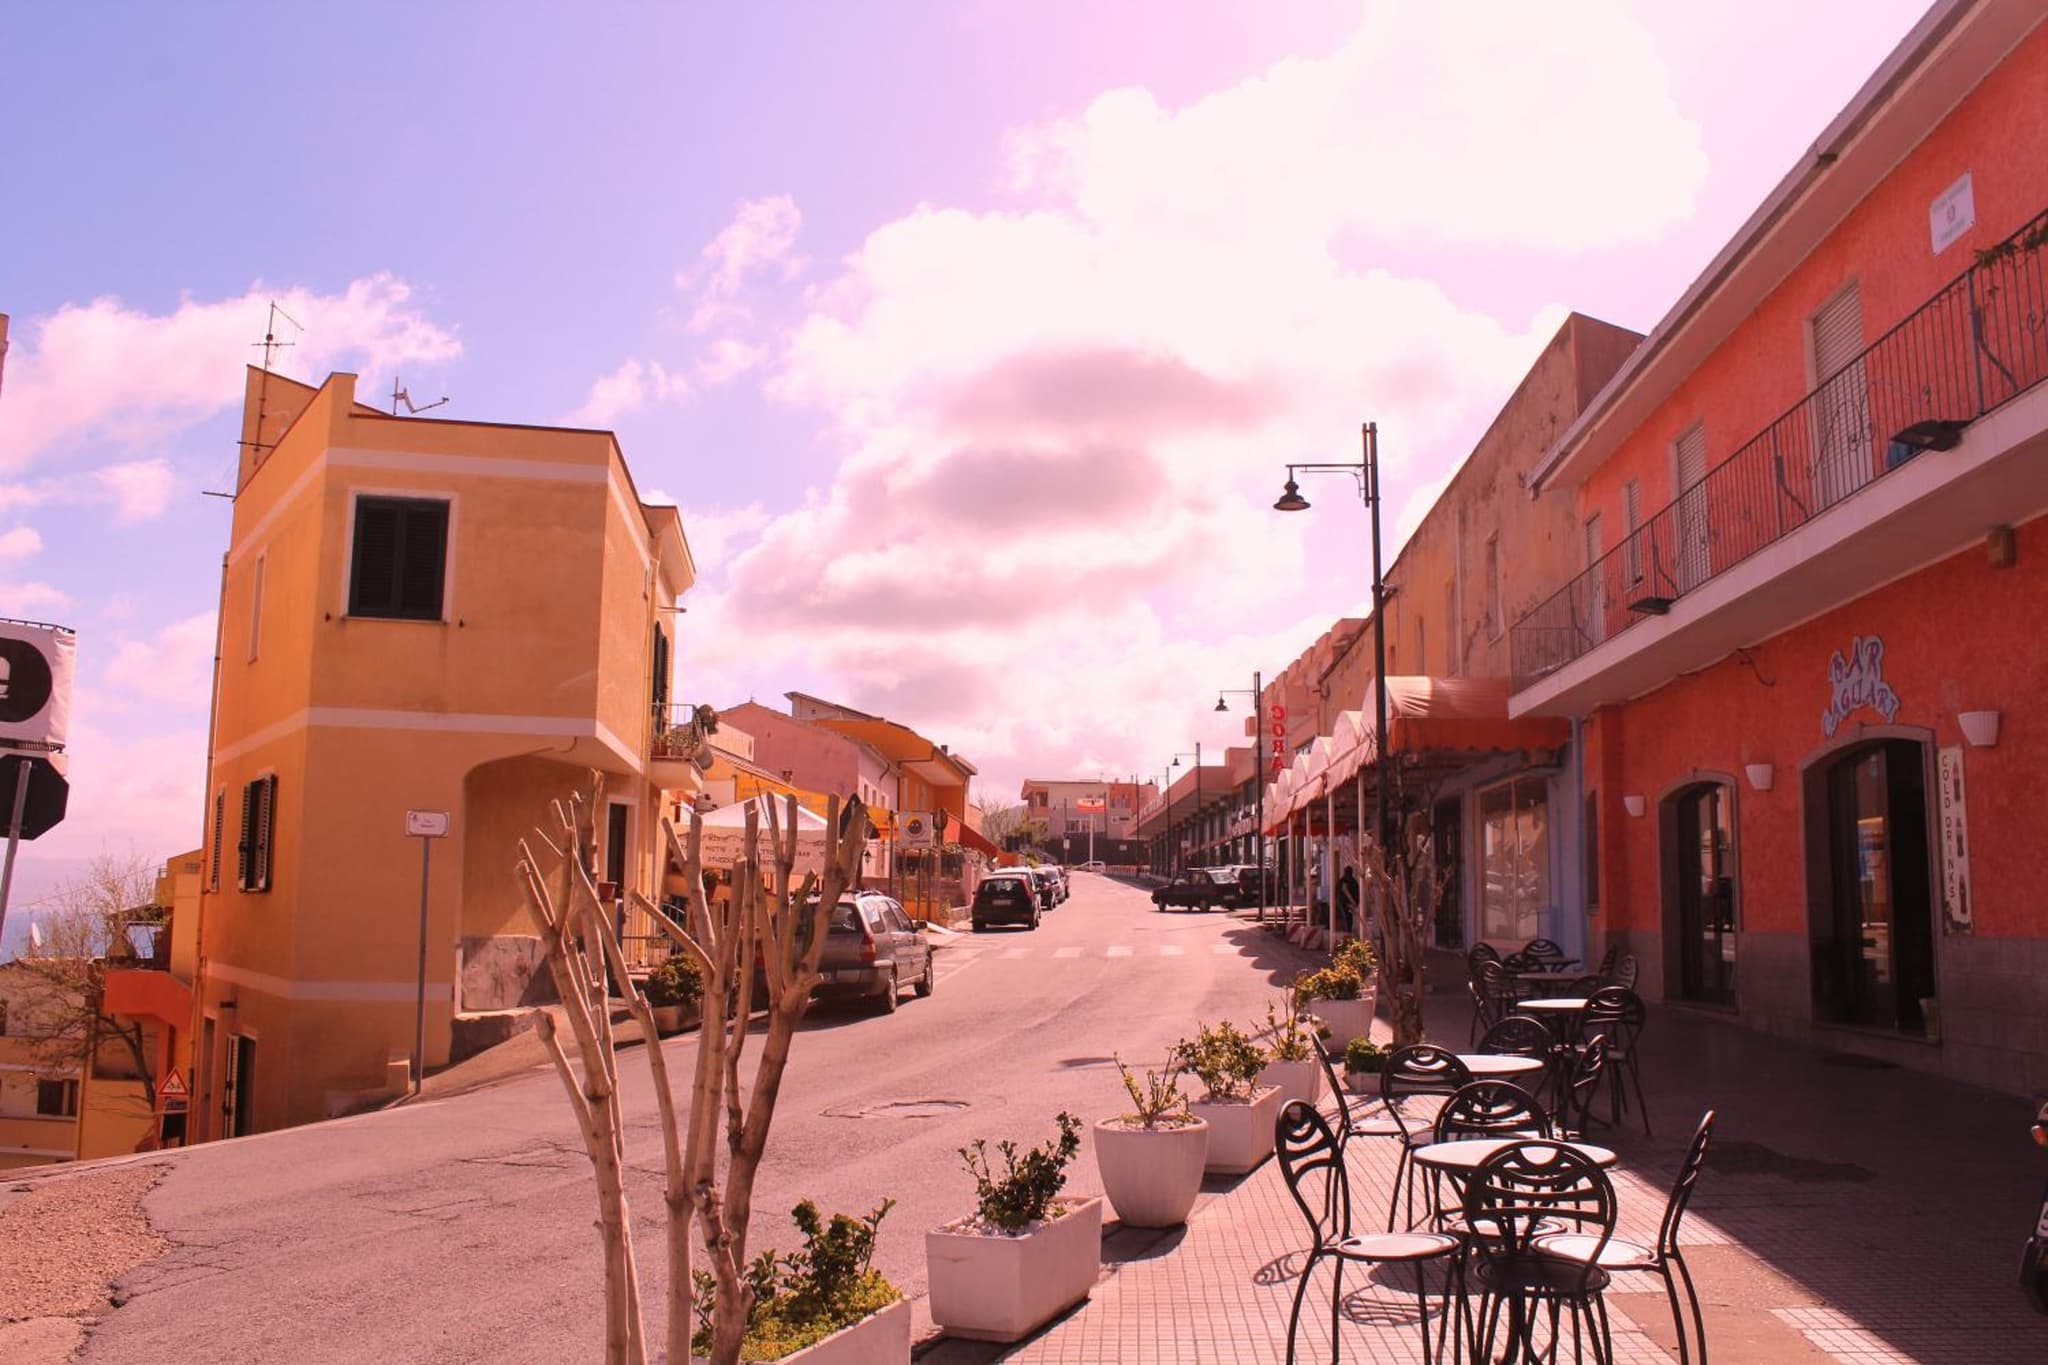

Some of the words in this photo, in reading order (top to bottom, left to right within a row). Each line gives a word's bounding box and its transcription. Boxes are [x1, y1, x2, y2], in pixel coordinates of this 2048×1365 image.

[1830, 638, 1882, 684] BAR
[1941, 755, 1951, 810] COLD
[1945, 816, 1956, 899] DRINKS
